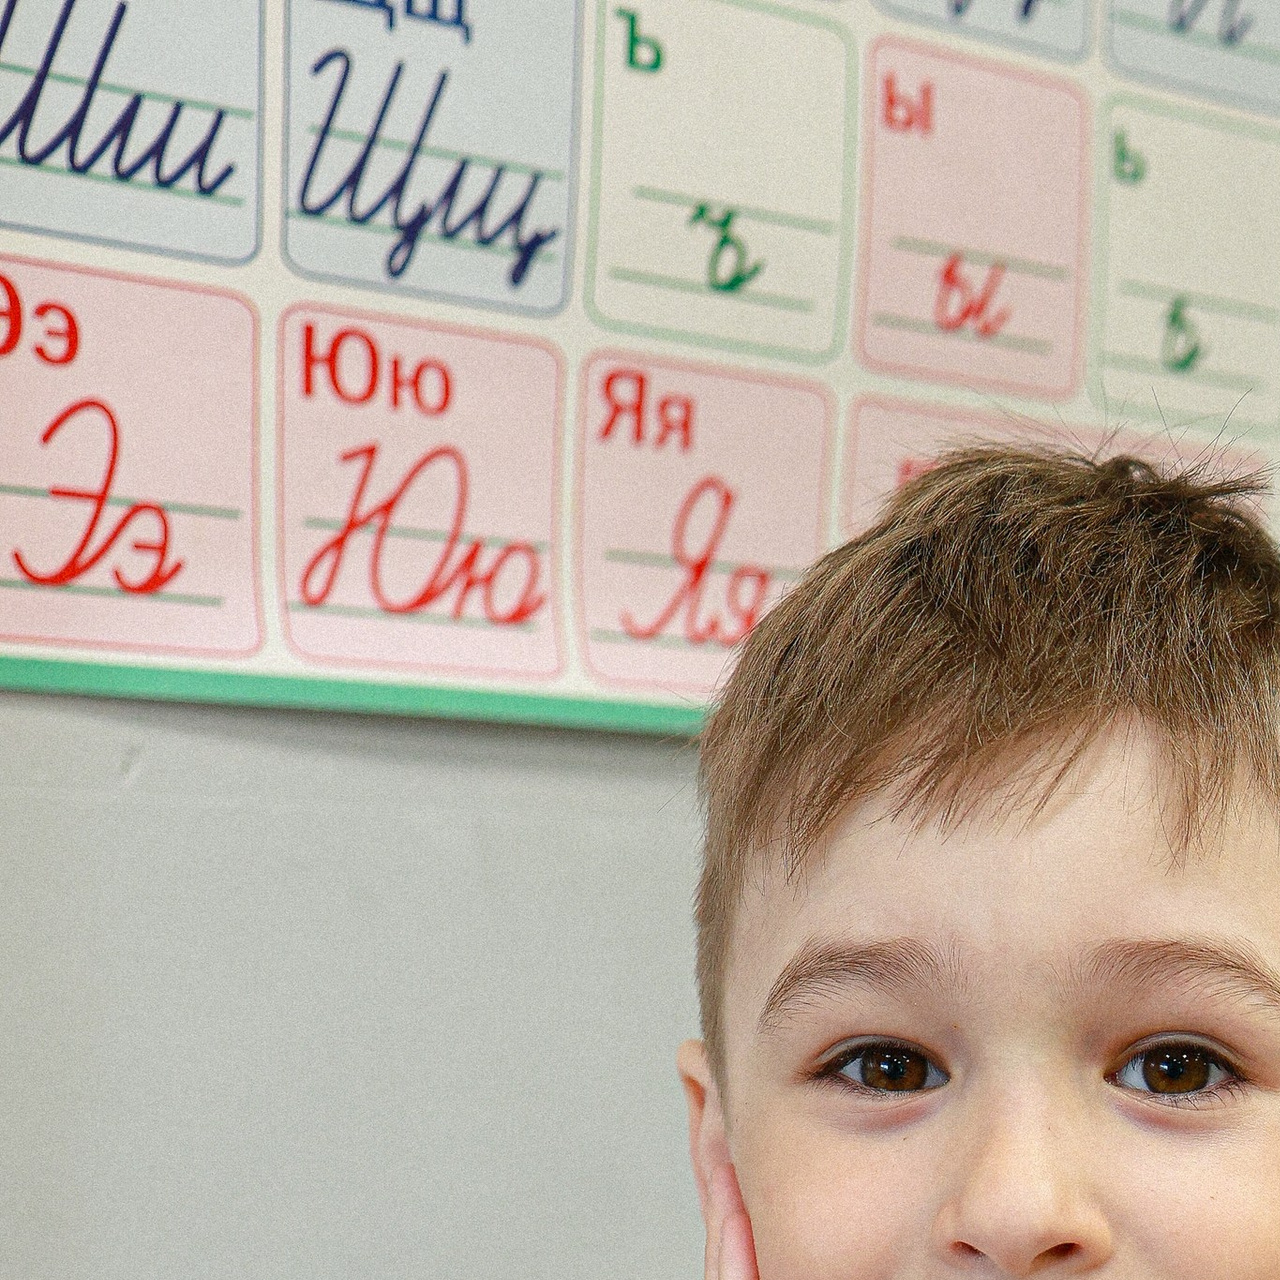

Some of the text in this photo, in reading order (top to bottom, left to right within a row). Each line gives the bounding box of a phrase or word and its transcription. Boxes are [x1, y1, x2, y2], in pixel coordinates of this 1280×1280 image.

[300, 49, 558, 286] Щщ
[304, 324, 451, 416] Юю
[600, 368, 694, 450] Яя
[13, 400, 184, 595] Ээ
[300, 441, 547, 625] Юю
[620, 476, 778, 647] Яя
